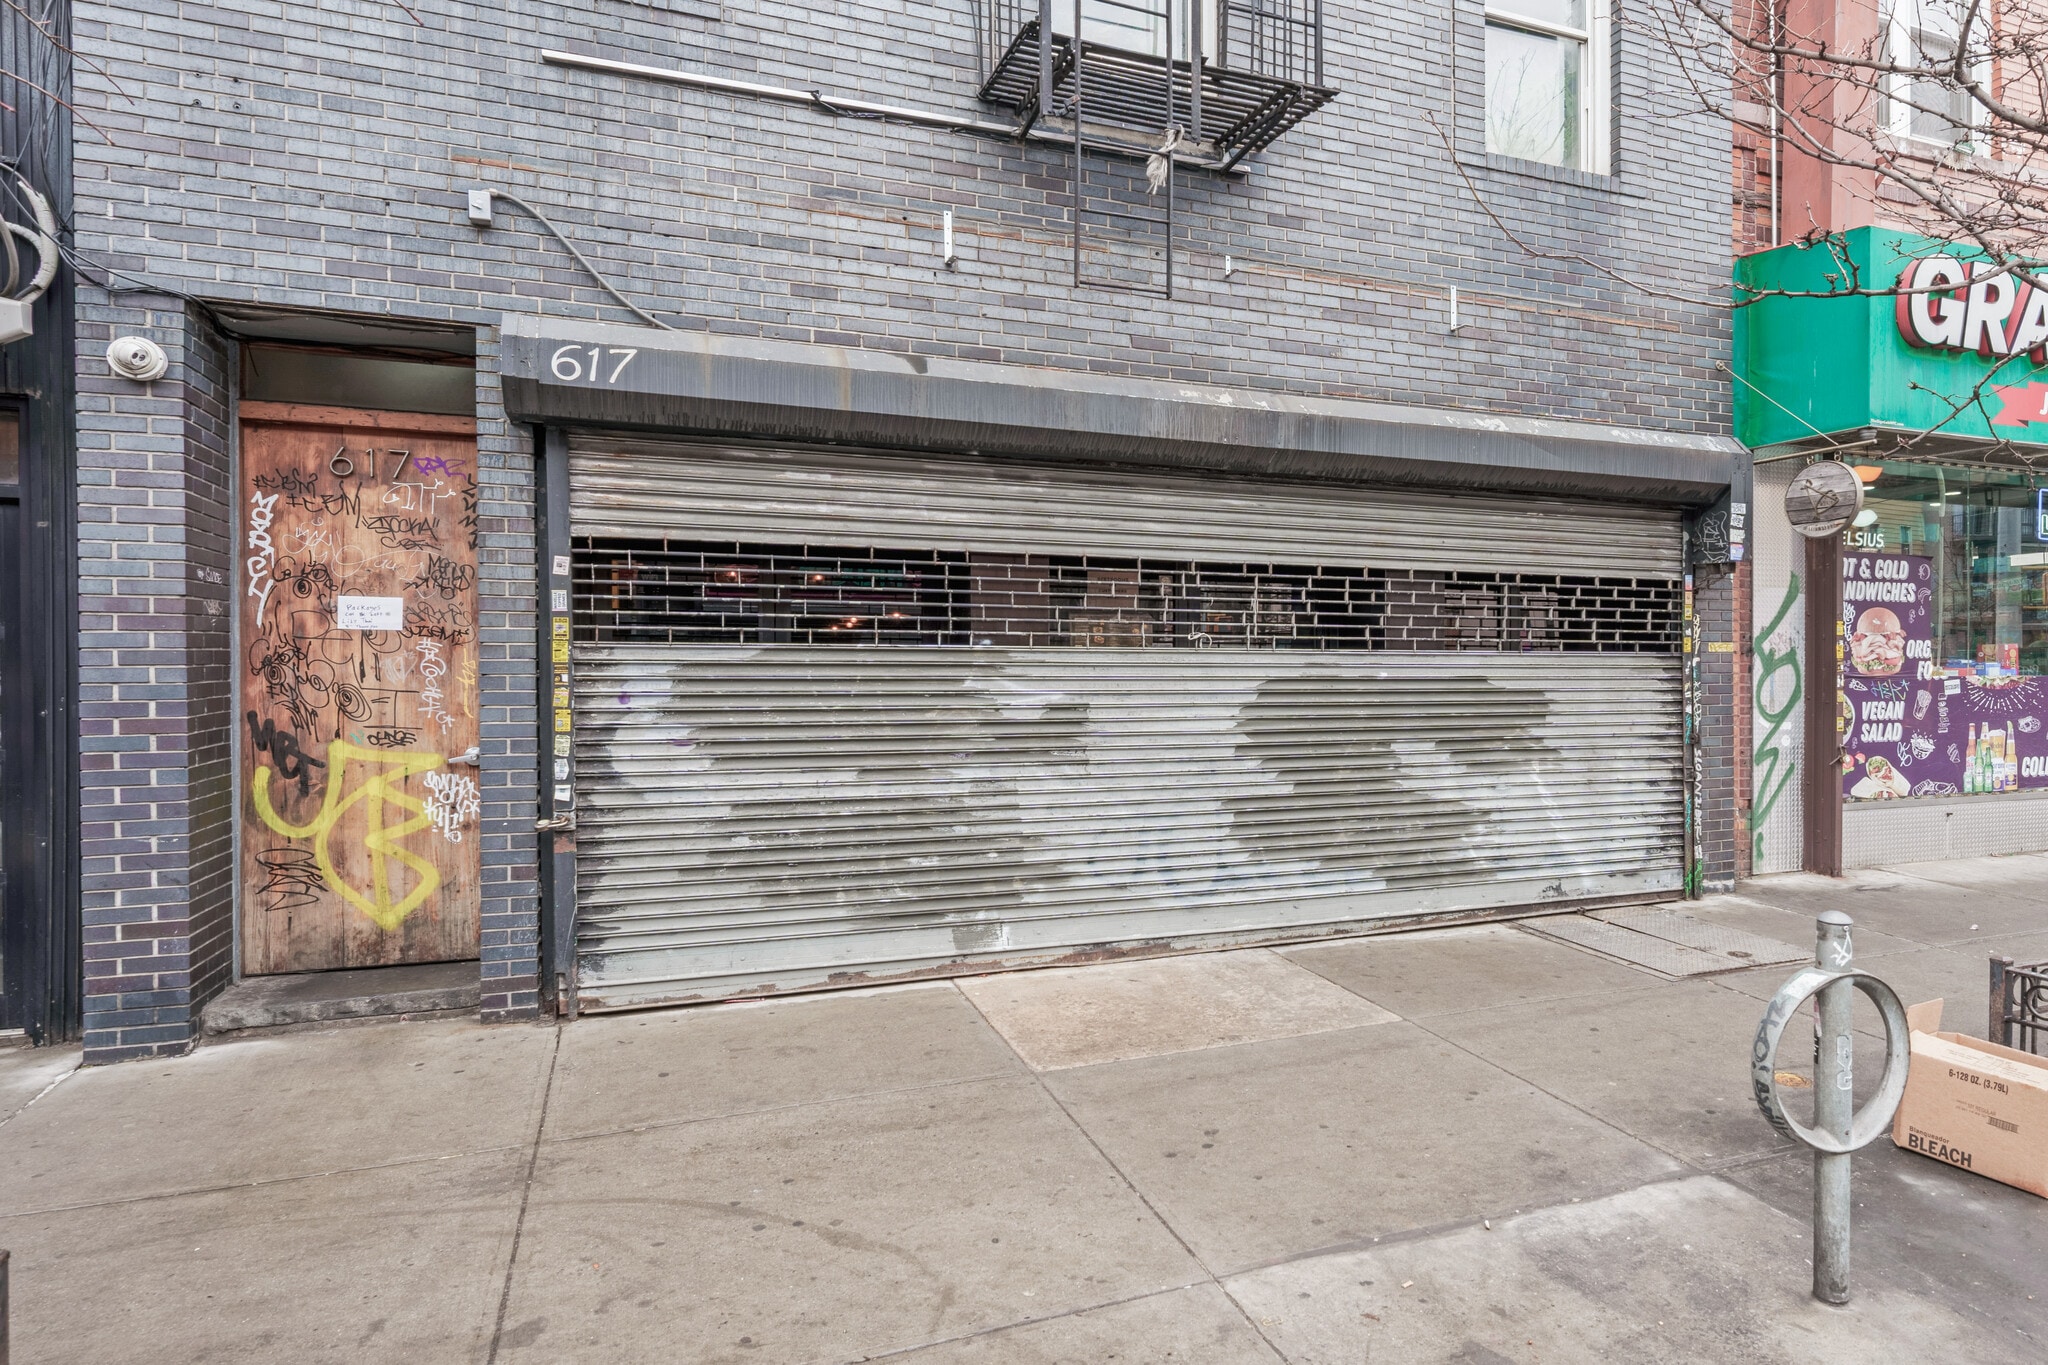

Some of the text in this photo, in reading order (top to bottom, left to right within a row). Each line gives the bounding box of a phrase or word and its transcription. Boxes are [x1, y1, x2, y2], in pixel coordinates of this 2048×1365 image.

[551, 345, 637, 384] 617
[329, 446, 410, 479] 617
[1843, 531, 1884, 547] LSIUS
[1859, 558, 1872, 579] &
[1875, 558, 1909, 580] COLD
[1843, 580, 1916, 603] NDWICHES
[1917, 660, 1949, 681] FO
[1861, 700, 1905, 721] VEGAN
[1860, 722, 1902, 743] SALAD
[2021, 756, 2048, 777] COL
[1948, 1068, 2009, 1095] 6-128 OZ. (3.79L)
[1908, 1125, 1950, 1144] Blanqueador
[1908, 1132, 1972, 1168] BLEACH
